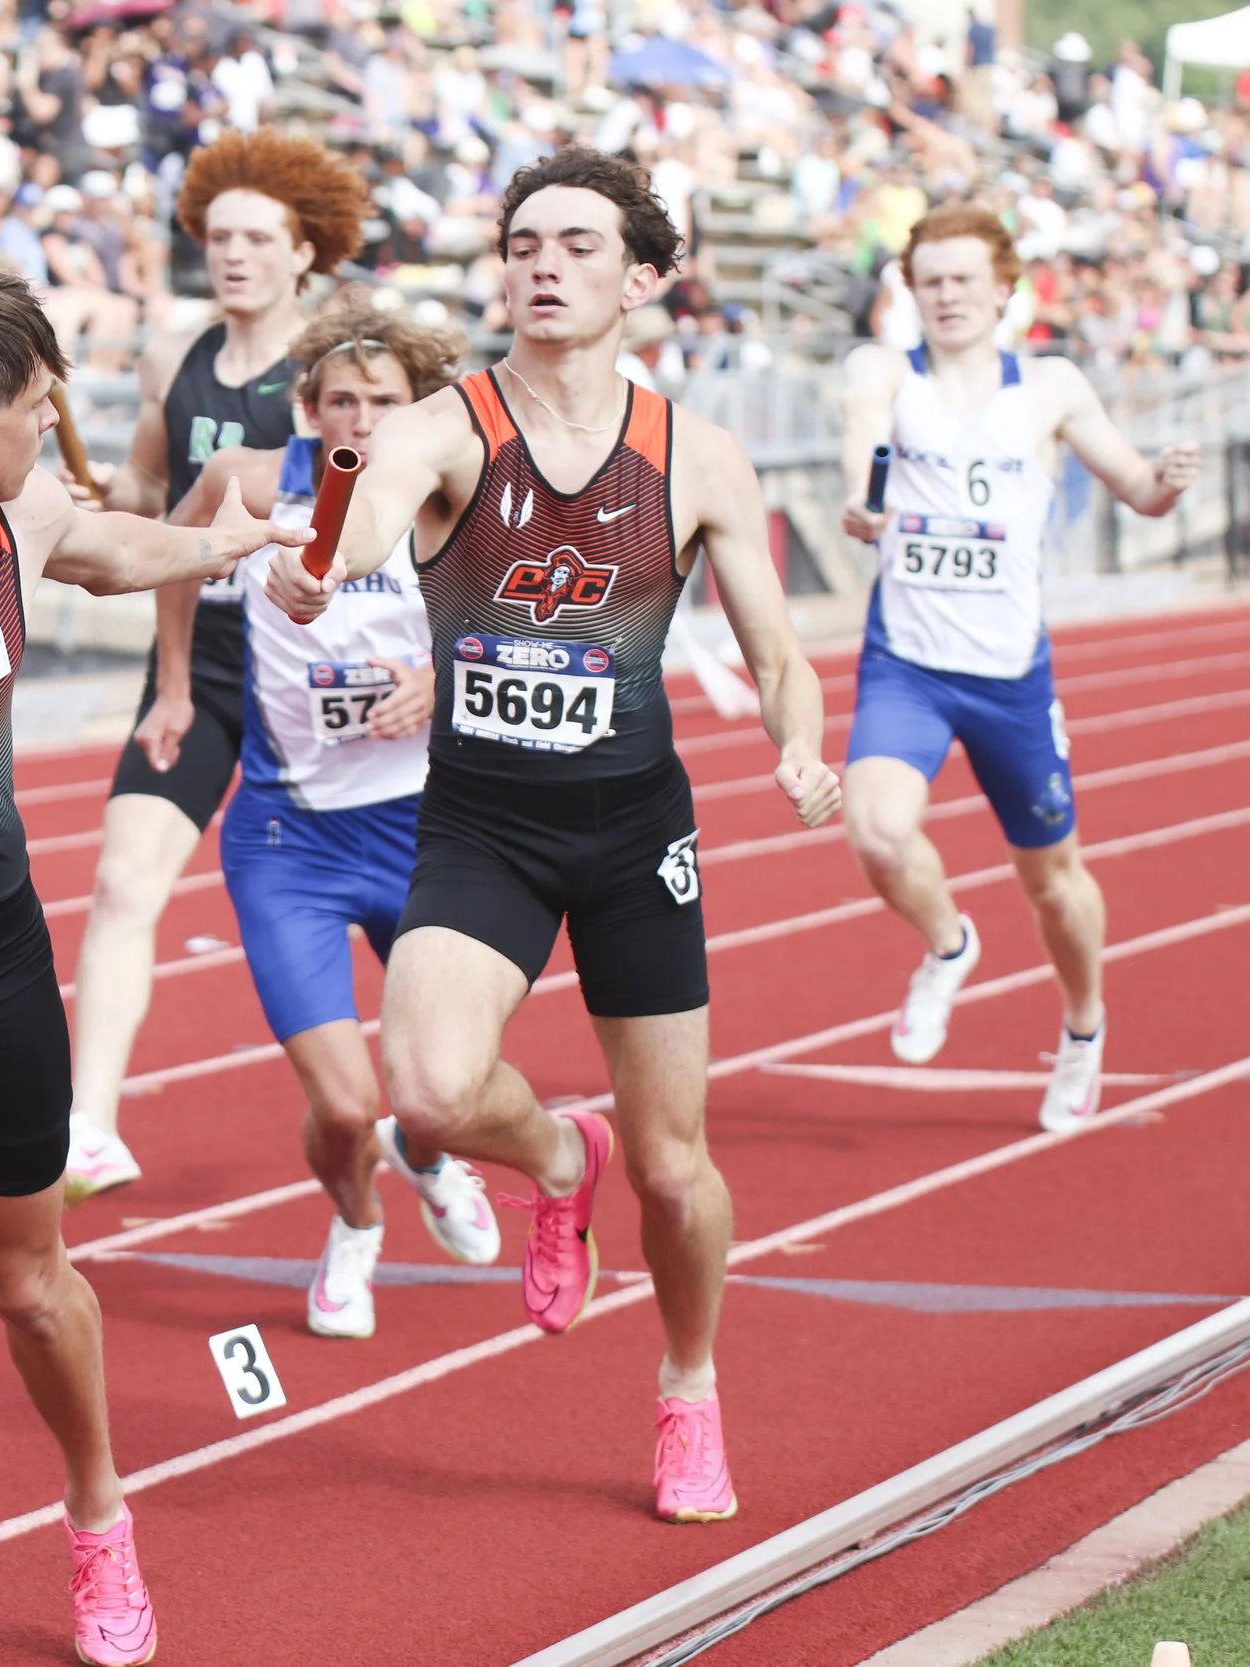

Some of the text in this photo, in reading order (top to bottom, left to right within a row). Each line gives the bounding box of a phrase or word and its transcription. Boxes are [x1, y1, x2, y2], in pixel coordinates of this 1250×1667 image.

[967, 459, 990, 506] 6
[905, 541, 997, 579] 5793
[496, 645, 570, 669] ZERO
[465, 670, 597, 734] 5694
[223, 1335, 270, 1404] 3
